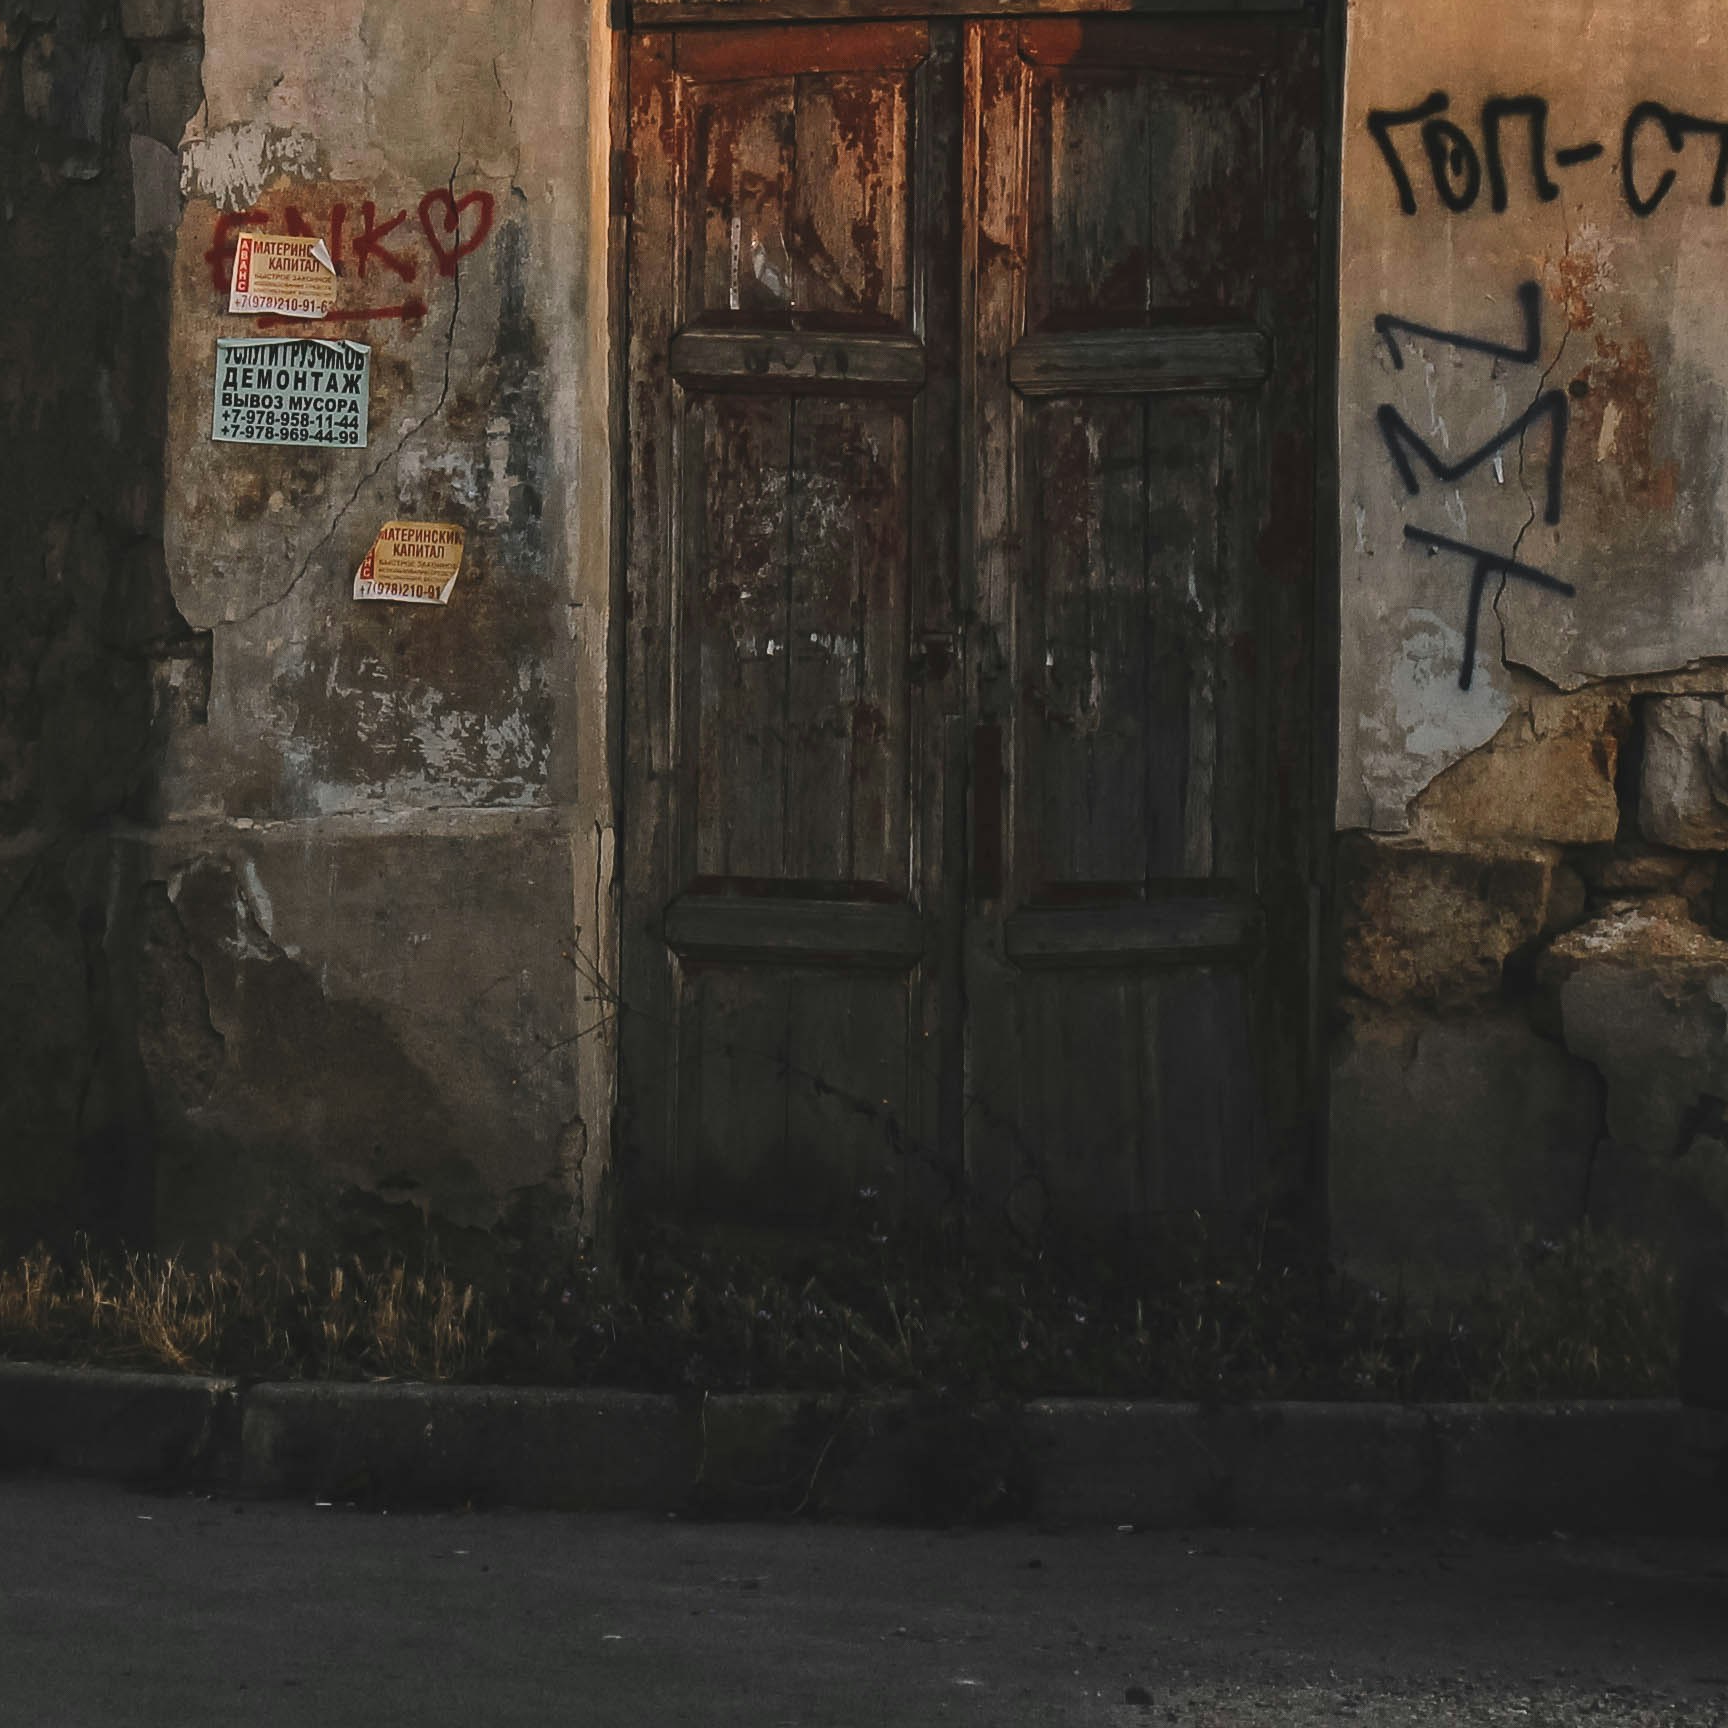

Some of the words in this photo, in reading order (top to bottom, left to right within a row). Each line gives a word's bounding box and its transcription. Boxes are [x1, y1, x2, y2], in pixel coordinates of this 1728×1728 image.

[253, 241, 314, 257] МАТЕРИНС
[236, 240, 251, 290] АВАНС
[268, 257, 320, 273] КАПИТАЛ
[222, 367, 362, 394] ДЕМОНТАЖ
[222, 393, 284, 409] ВЫВОЗ
[288, 396, 360, 414] МУСОРА
[222, 409, 359, 430] +7-978-958-11-44
[221, 425, 359, 444] +7-978-969-44-99
[393, 543, 445, 559] КАПИТАЛ
